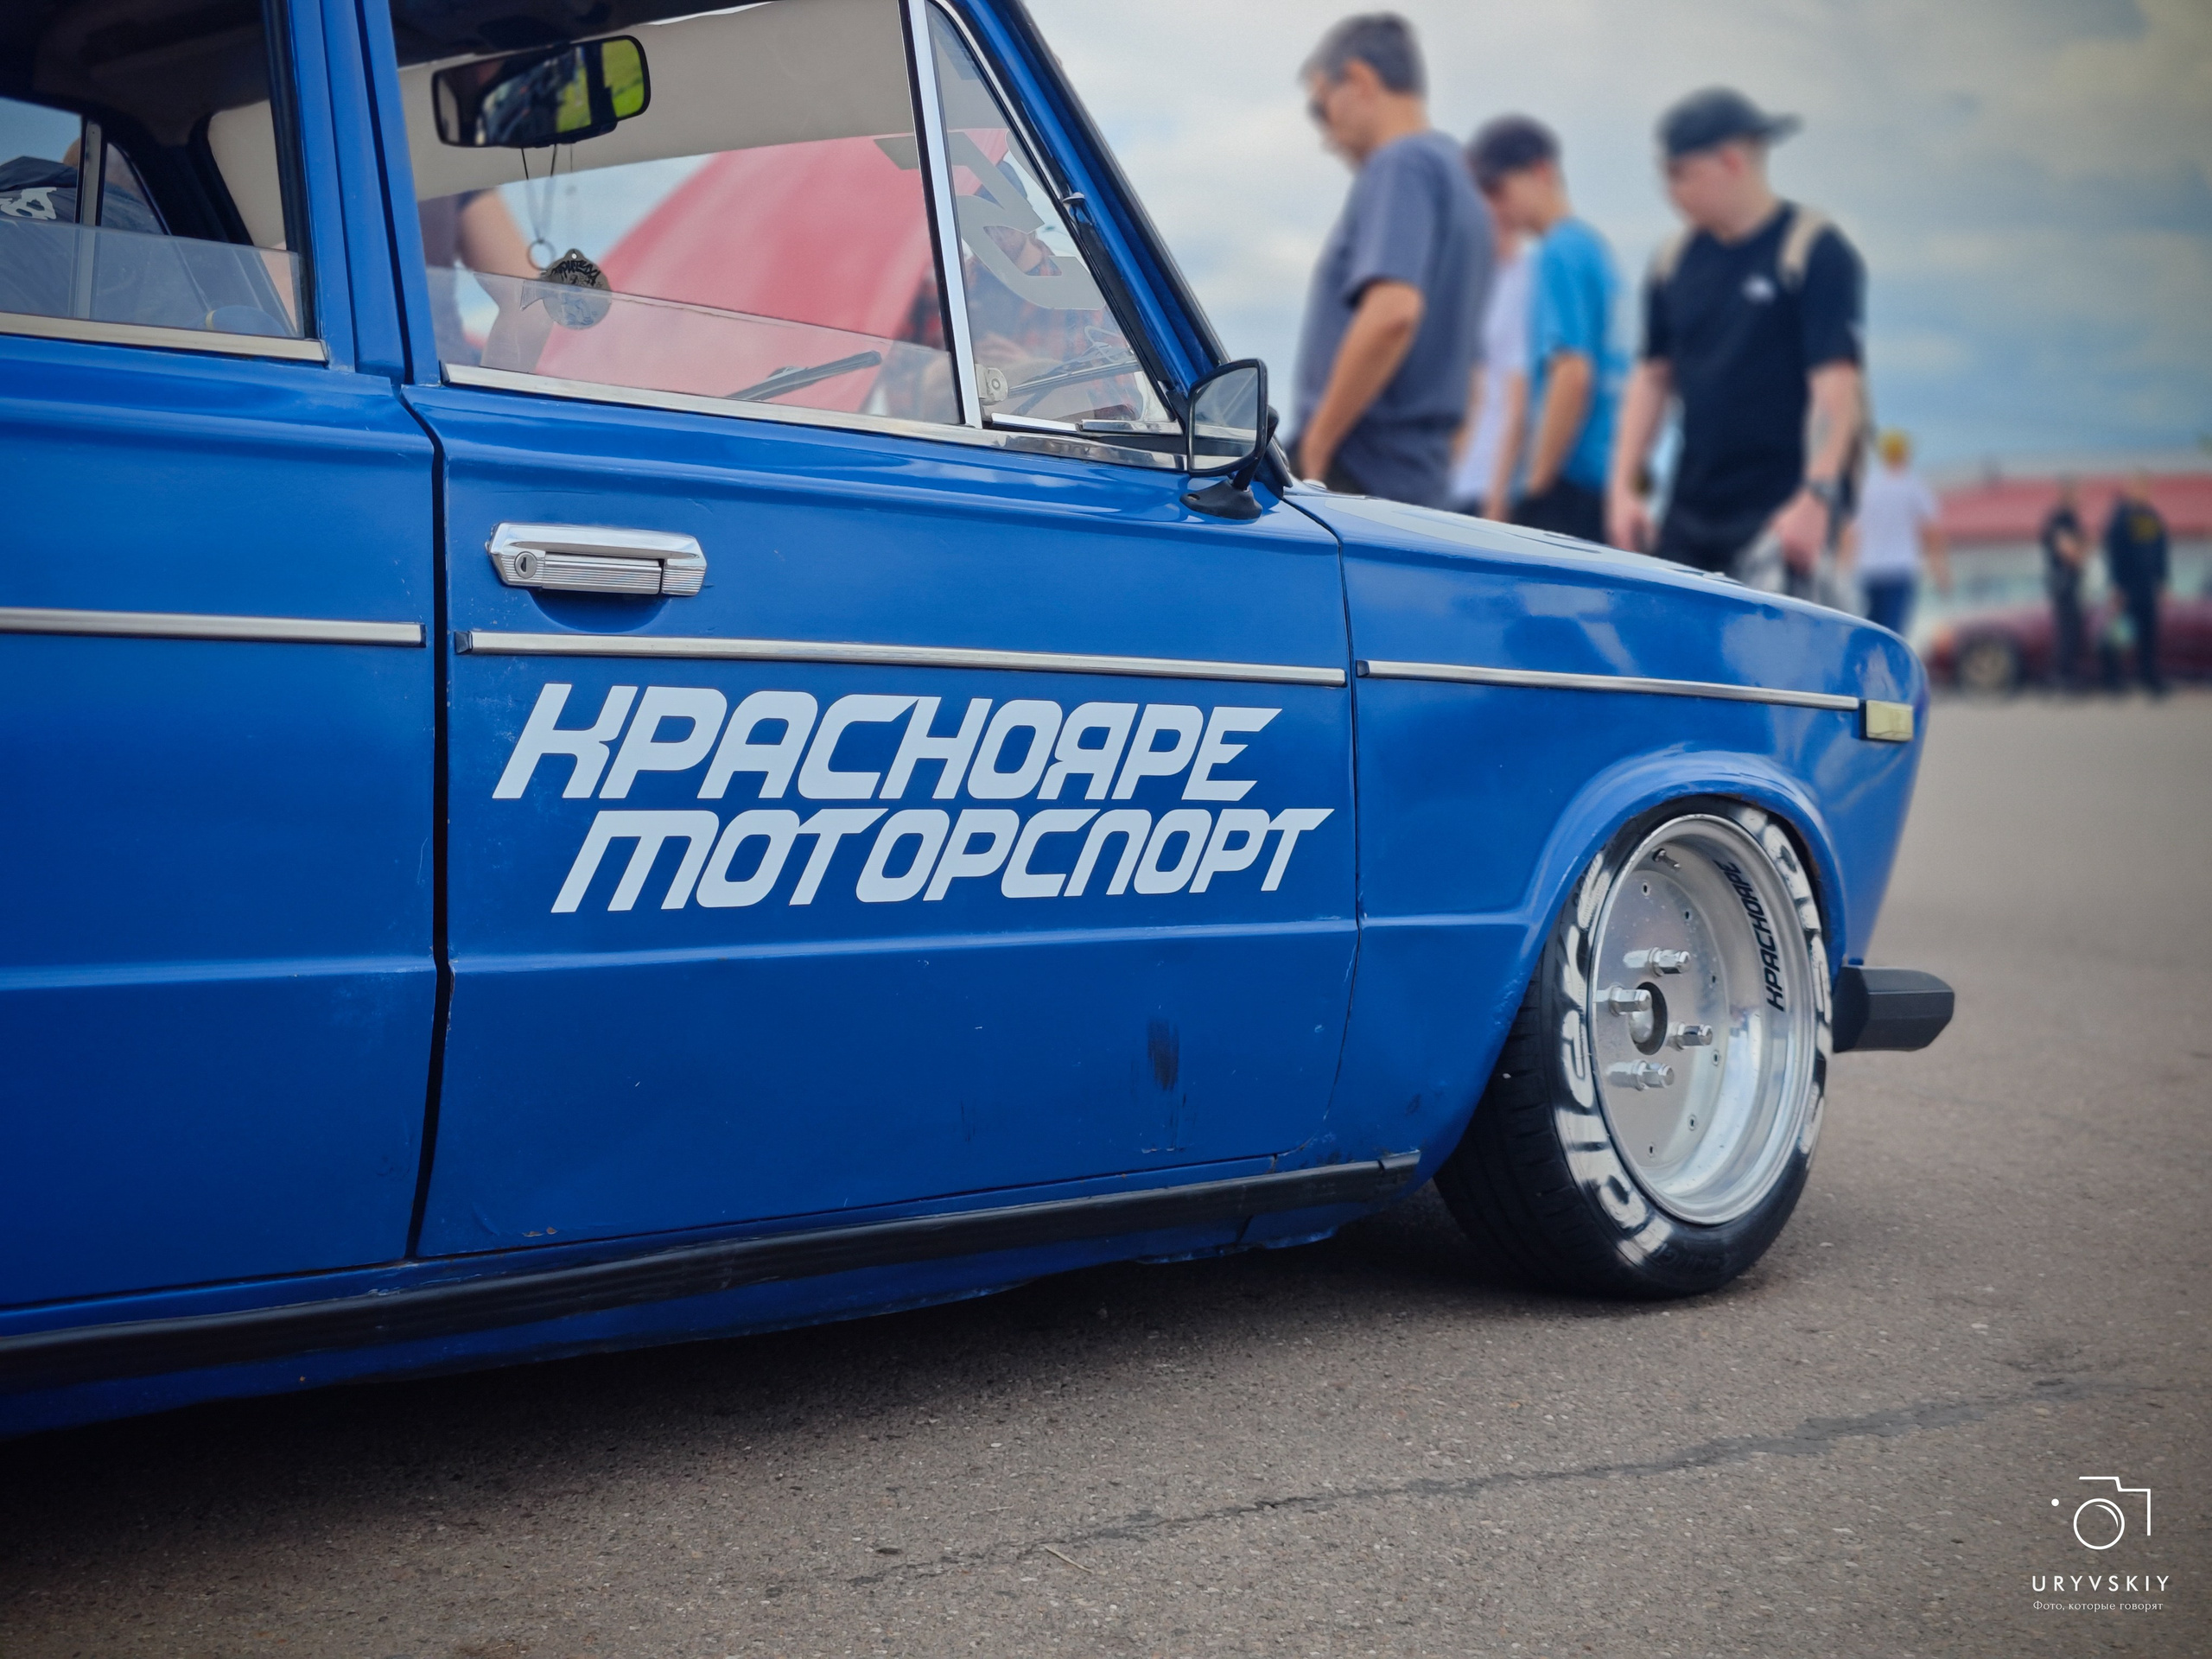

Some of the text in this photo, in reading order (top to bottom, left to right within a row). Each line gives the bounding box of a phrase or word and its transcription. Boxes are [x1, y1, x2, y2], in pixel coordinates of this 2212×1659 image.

[493, 683, 1282, 800] КРАСНОЯРЕ
[550, 808, 1334, 913] МОТОРСПОРТ
[1712, 859, 1786, 1013] КРАСНОЯРЕ
